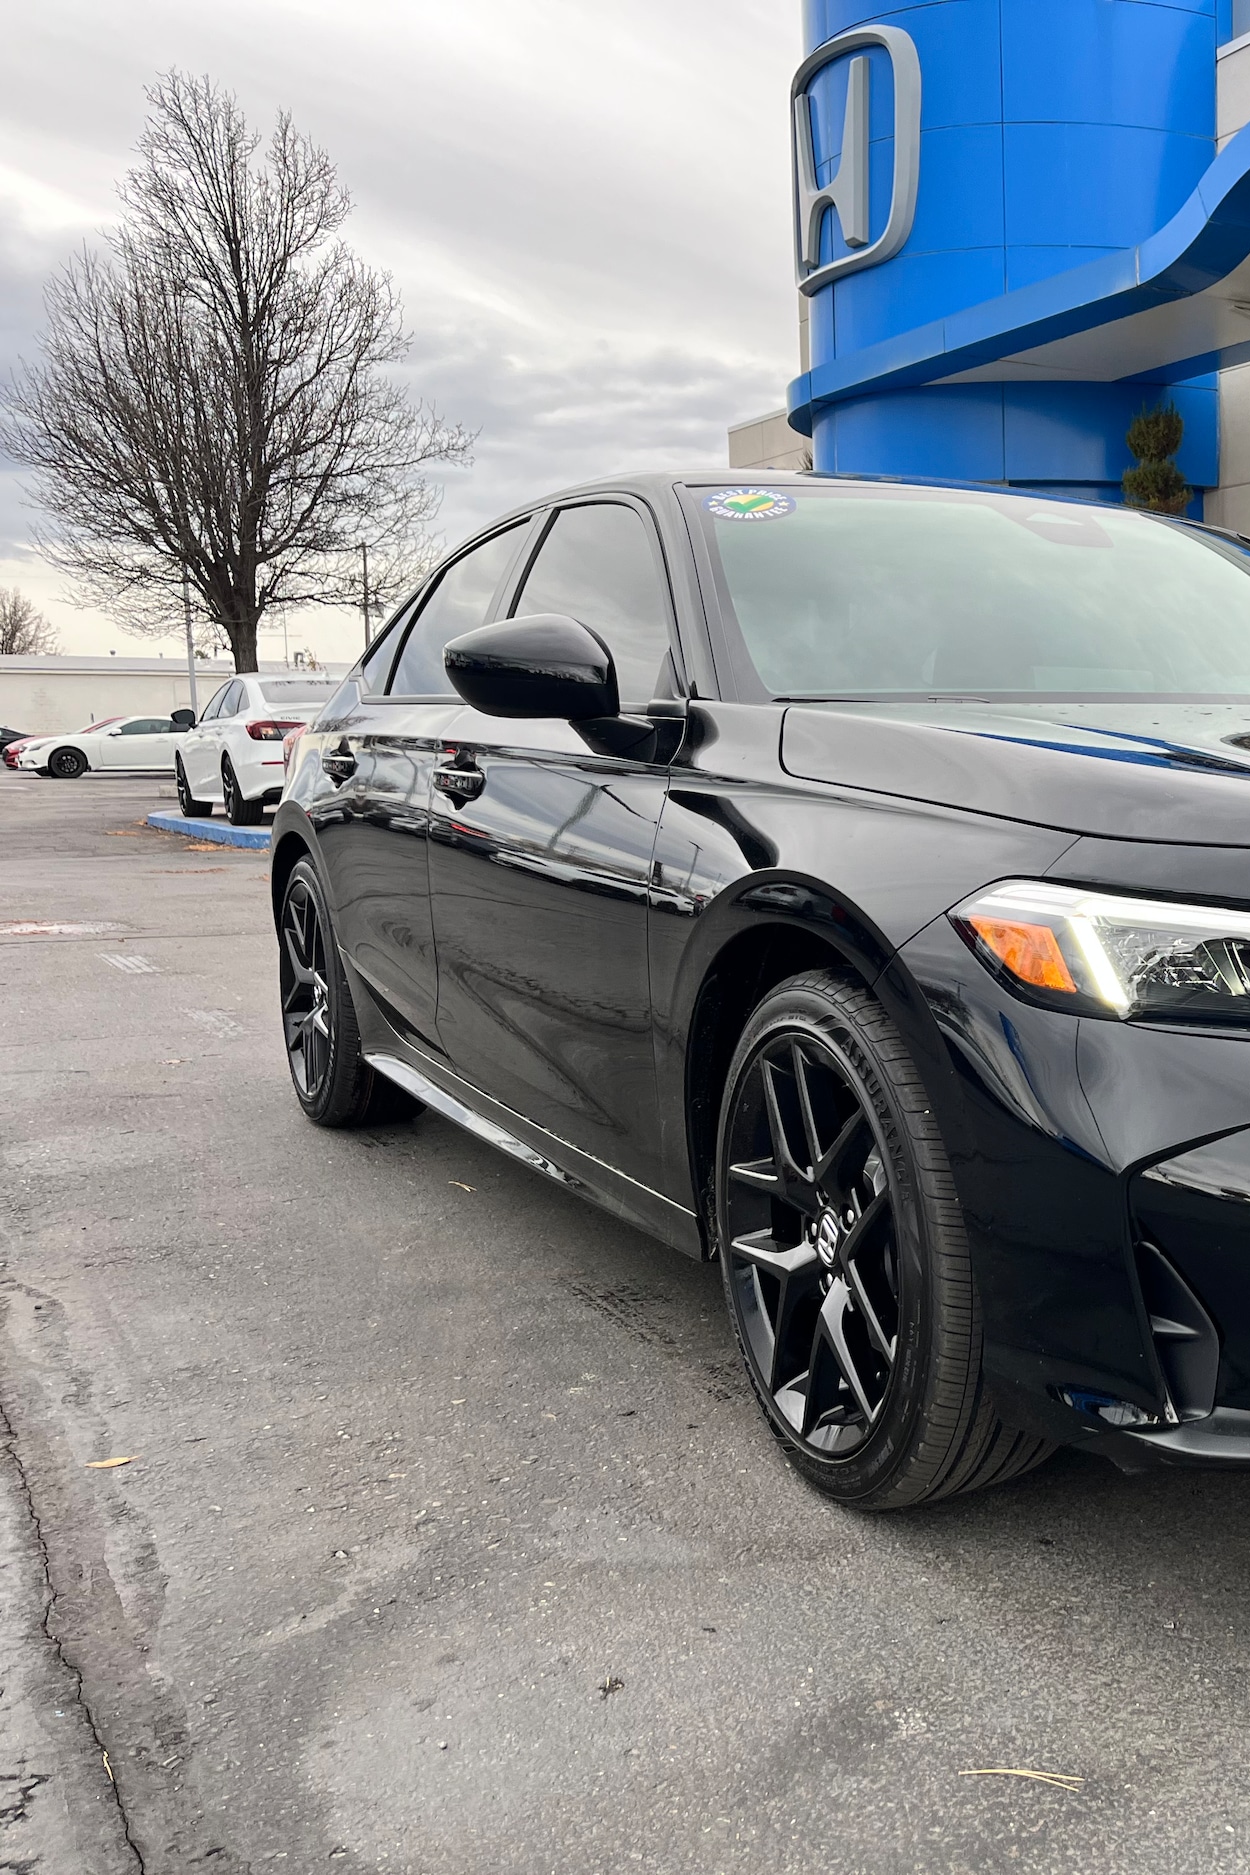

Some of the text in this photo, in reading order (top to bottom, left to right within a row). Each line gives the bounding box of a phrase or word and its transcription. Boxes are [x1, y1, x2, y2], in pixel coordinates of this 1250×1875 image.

[711, 489, 788, 501] BEST PRICE
[709, 506, 788, 519] GUARANTEE
